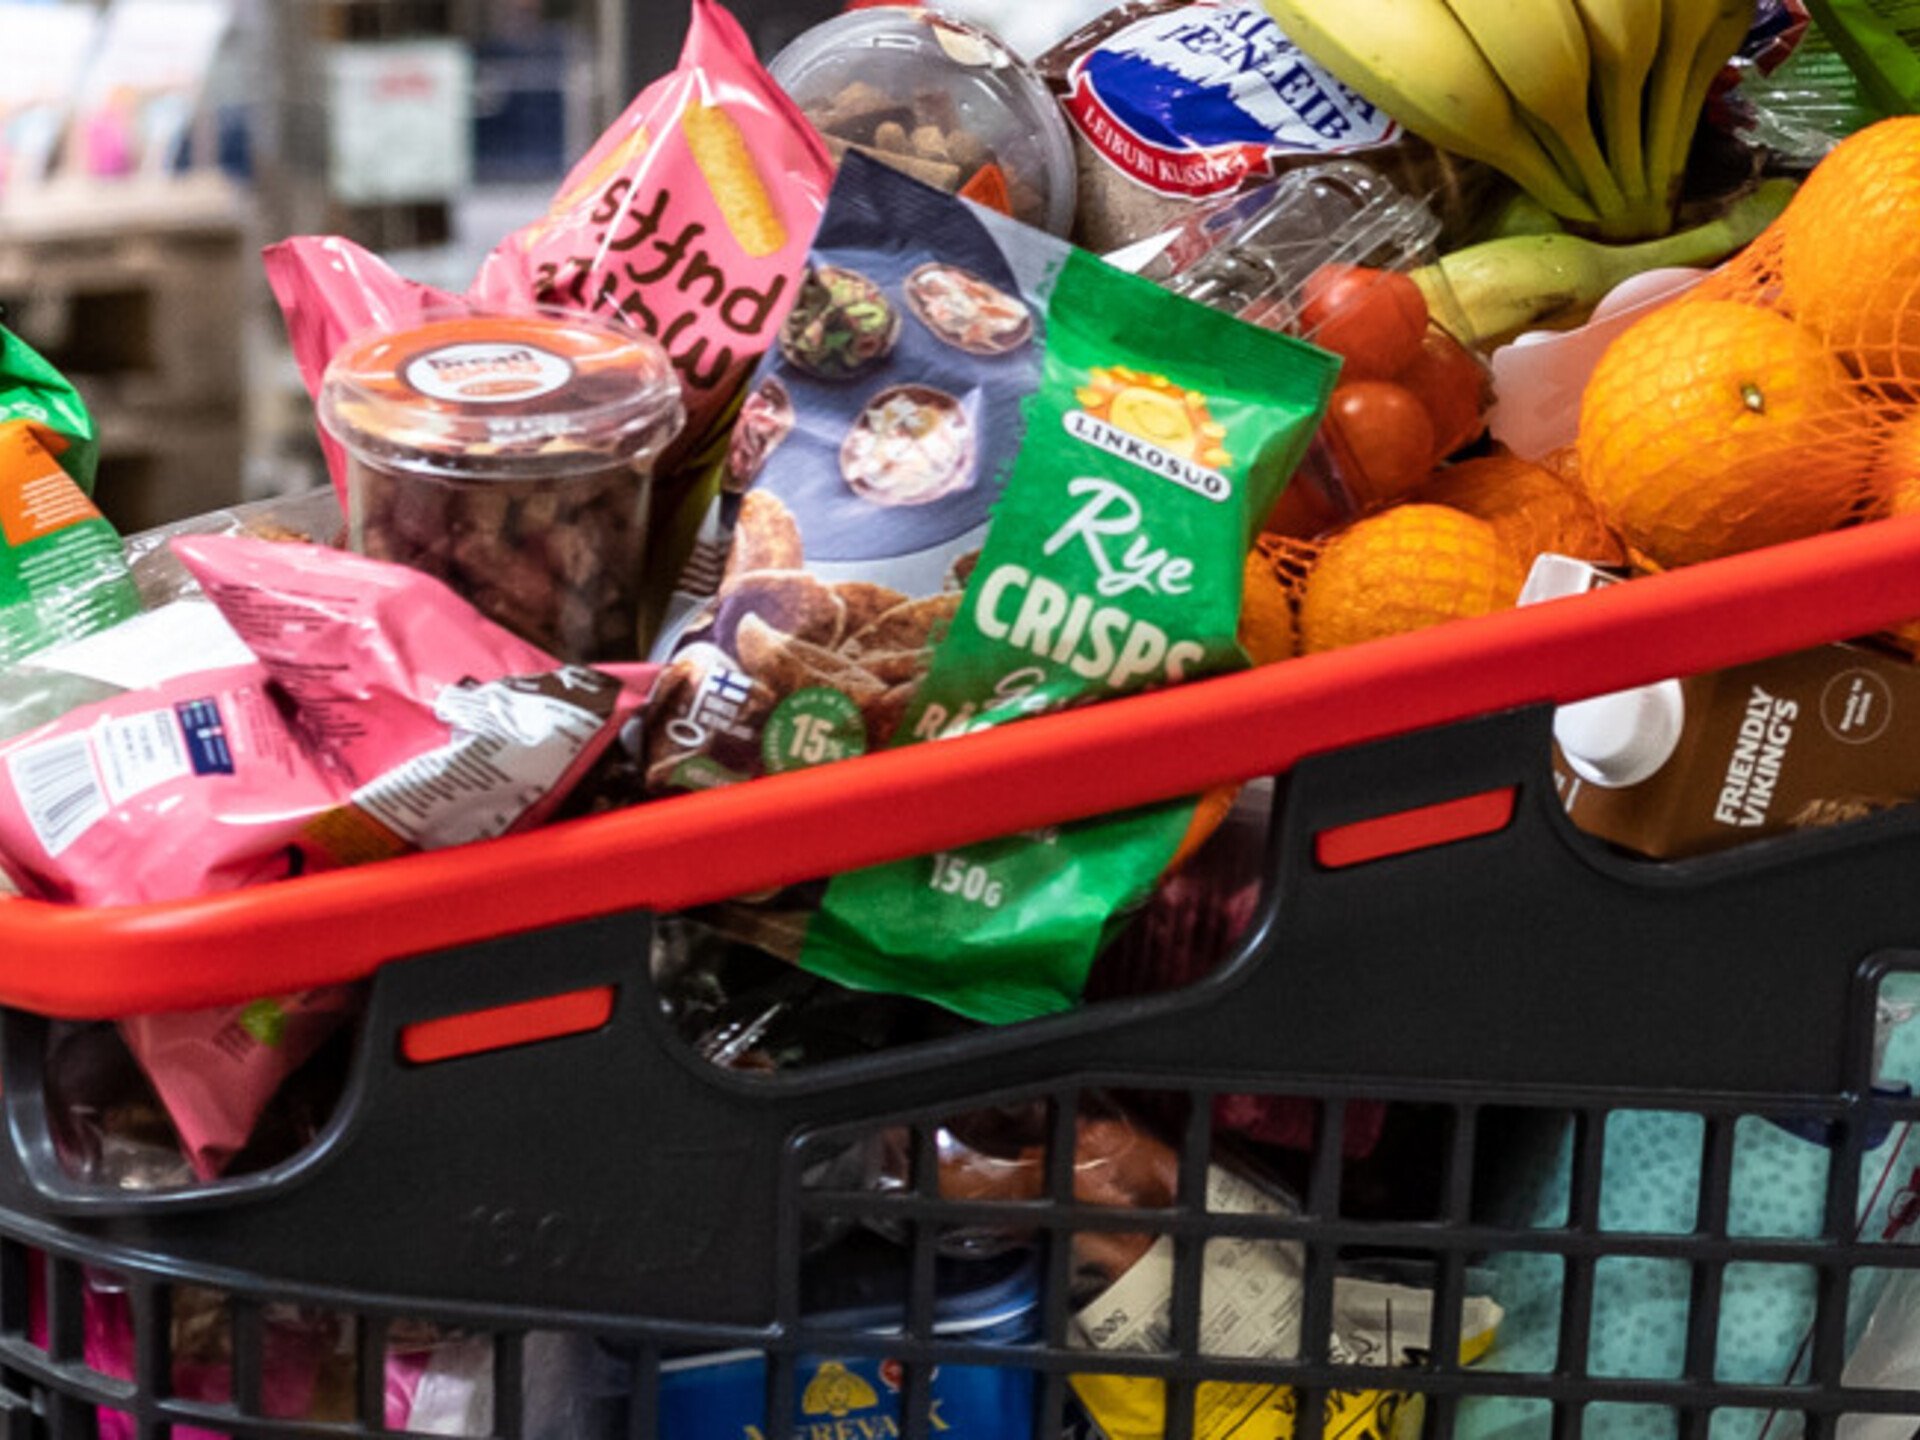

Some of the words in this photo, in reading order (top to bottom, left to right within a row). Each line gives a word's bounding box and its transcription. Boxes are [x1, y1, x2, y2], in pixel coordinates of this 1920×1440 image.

[1083, 106, 1155, 177] LEIBURI
[591, 177, 788, 336] puffs
[1073, 416, 1223, 495] LINKOSUO
[1043, 476, 1195, 598] Rye
[1713, 685, 1774, 824] FRIENDLY
[1739, 698, 1798, 827] VIKING'S
